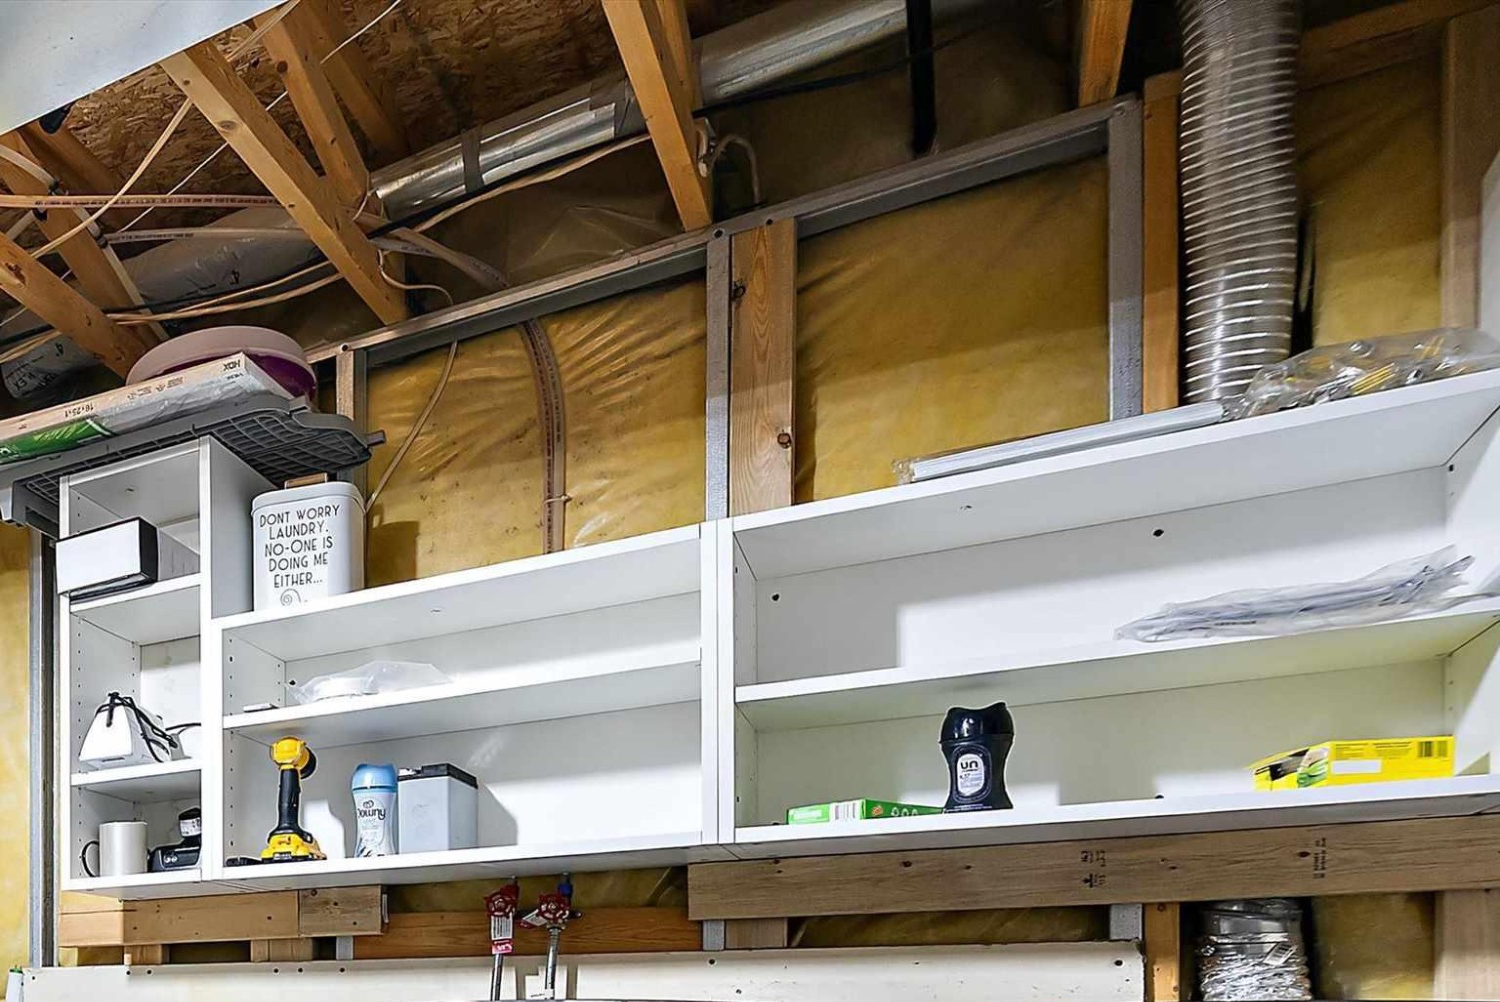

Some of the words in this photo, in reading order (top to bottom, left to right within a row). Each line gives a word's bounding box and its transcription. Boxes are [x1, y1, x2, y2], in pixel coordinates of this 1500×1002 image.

[260, 511, 290, 528] DONT
[296, 504, 340, 520] WORRY
[269, 520, 329, 540] LAUNDRY.
[265, 538, 317, 557] NO-ONE
[322, 535, 334, 549] IS
[268, 555, 308, 572] DOING
[313, 551, 328, 566] ME
[273, 571, 323, 588] EITHER...
